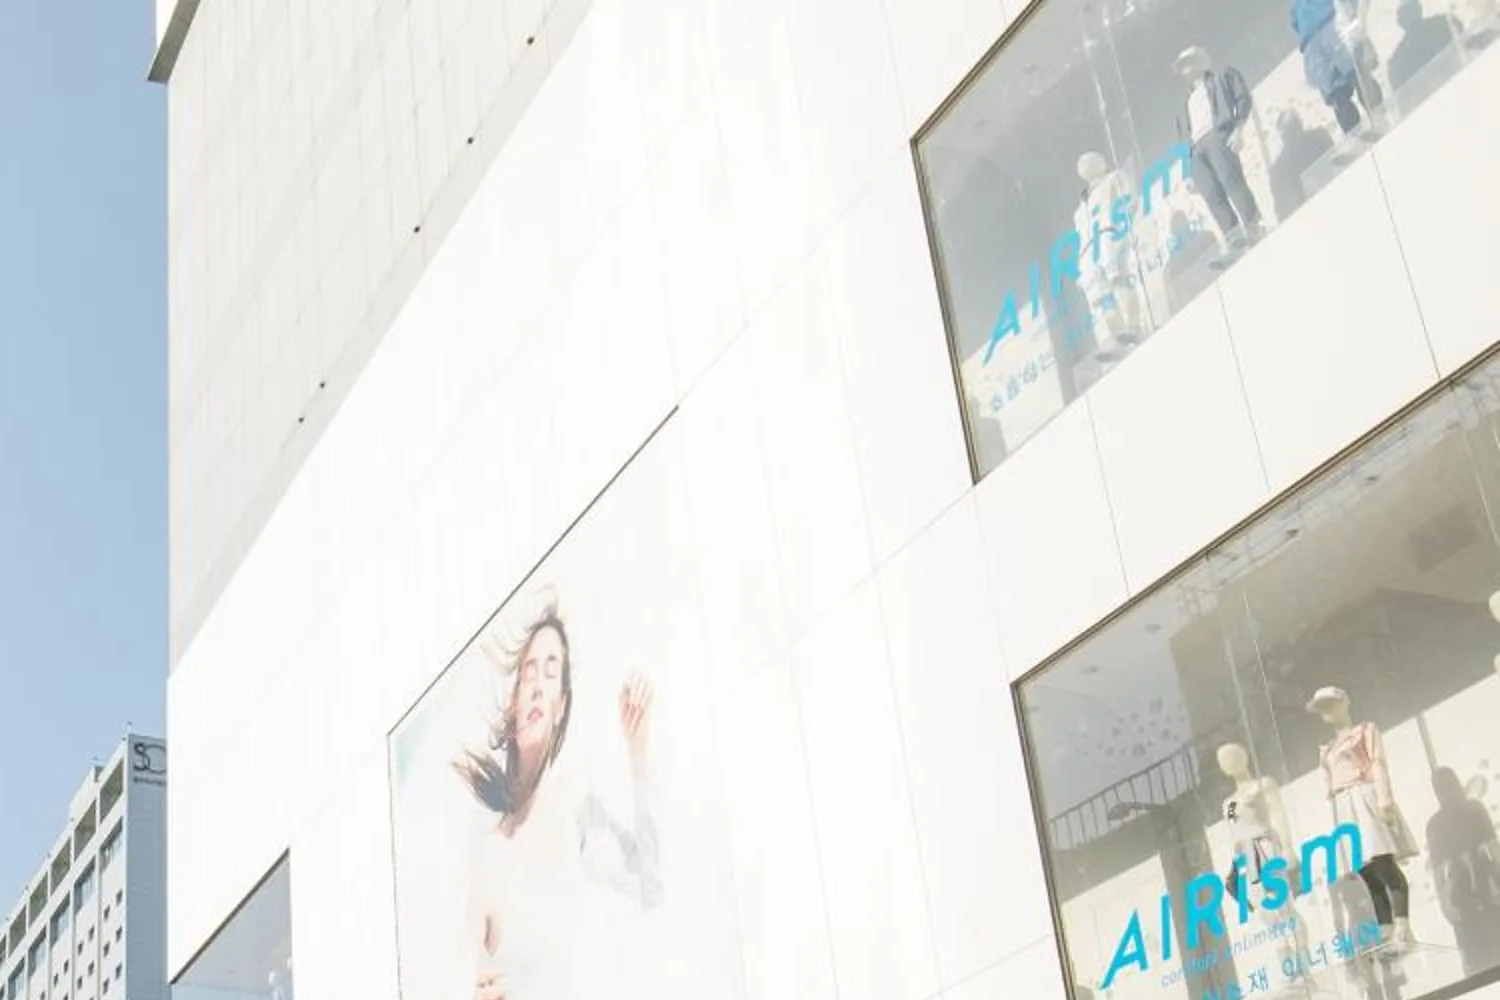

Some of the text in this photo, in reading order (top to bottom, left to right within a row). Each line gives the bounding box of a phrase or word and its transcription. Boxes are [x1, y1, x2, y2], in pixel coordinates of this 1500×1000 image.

[982, 142, 1191, 368] AIRism
[1100, 822, 1365, 990] AIRism
[1282, 920, 1381, 982] 이너웨어
